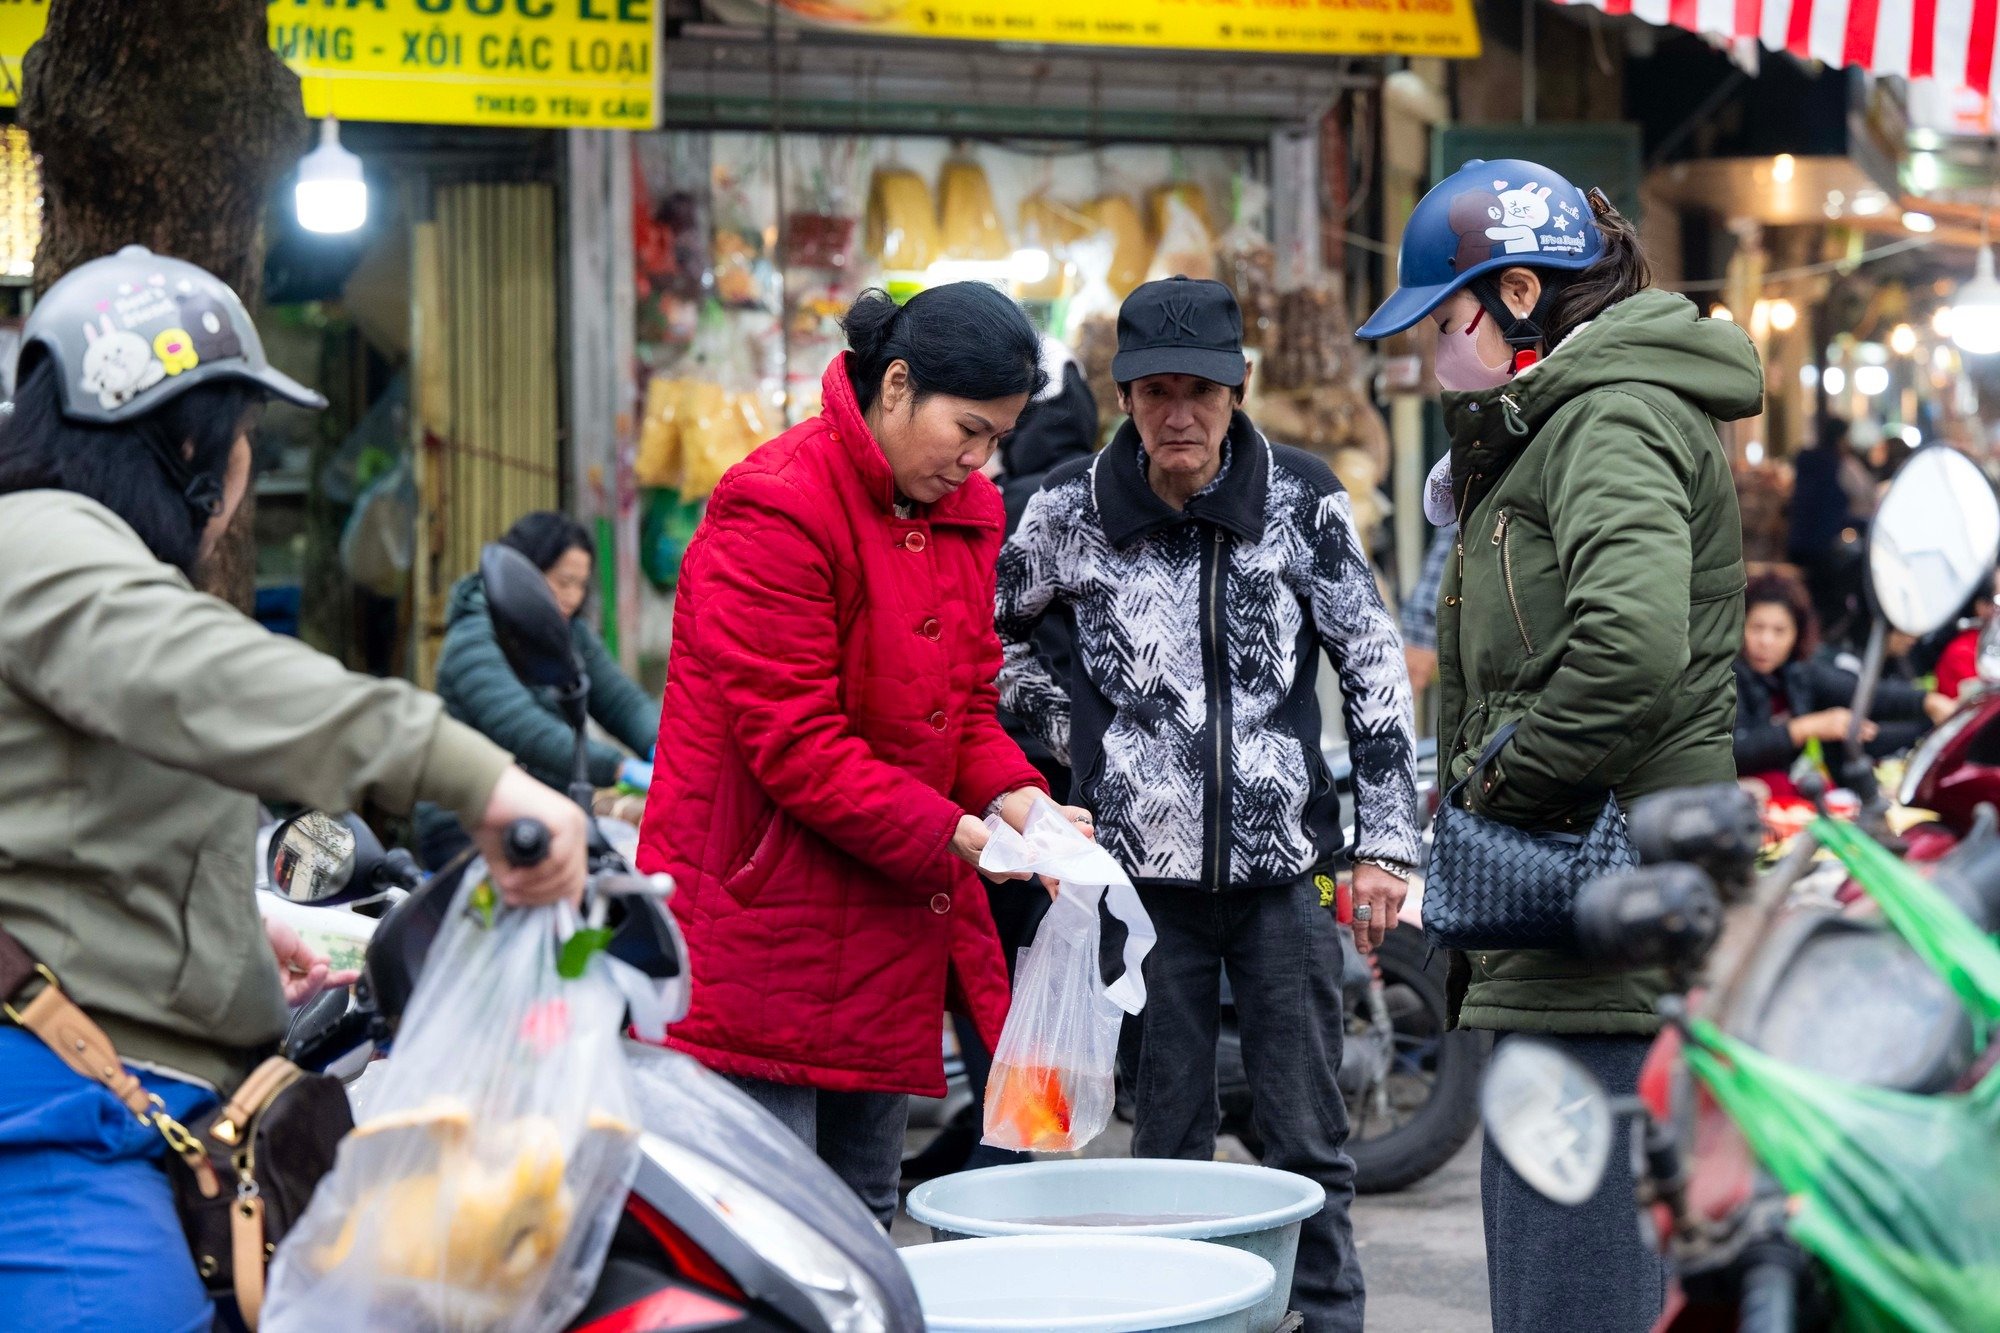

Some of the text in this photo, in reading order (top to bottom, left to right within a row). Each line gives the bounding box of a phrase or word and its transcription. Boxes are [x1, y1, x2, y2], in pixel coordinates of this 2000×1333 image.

[402, 26, 463, 67] XÔI
[479, 26, 553, 71] CÁC
[569, 38, 649, 84] LOẠI
[475, 95, 538, 115] THEO
[1158, 298, 1199, 340] NY
